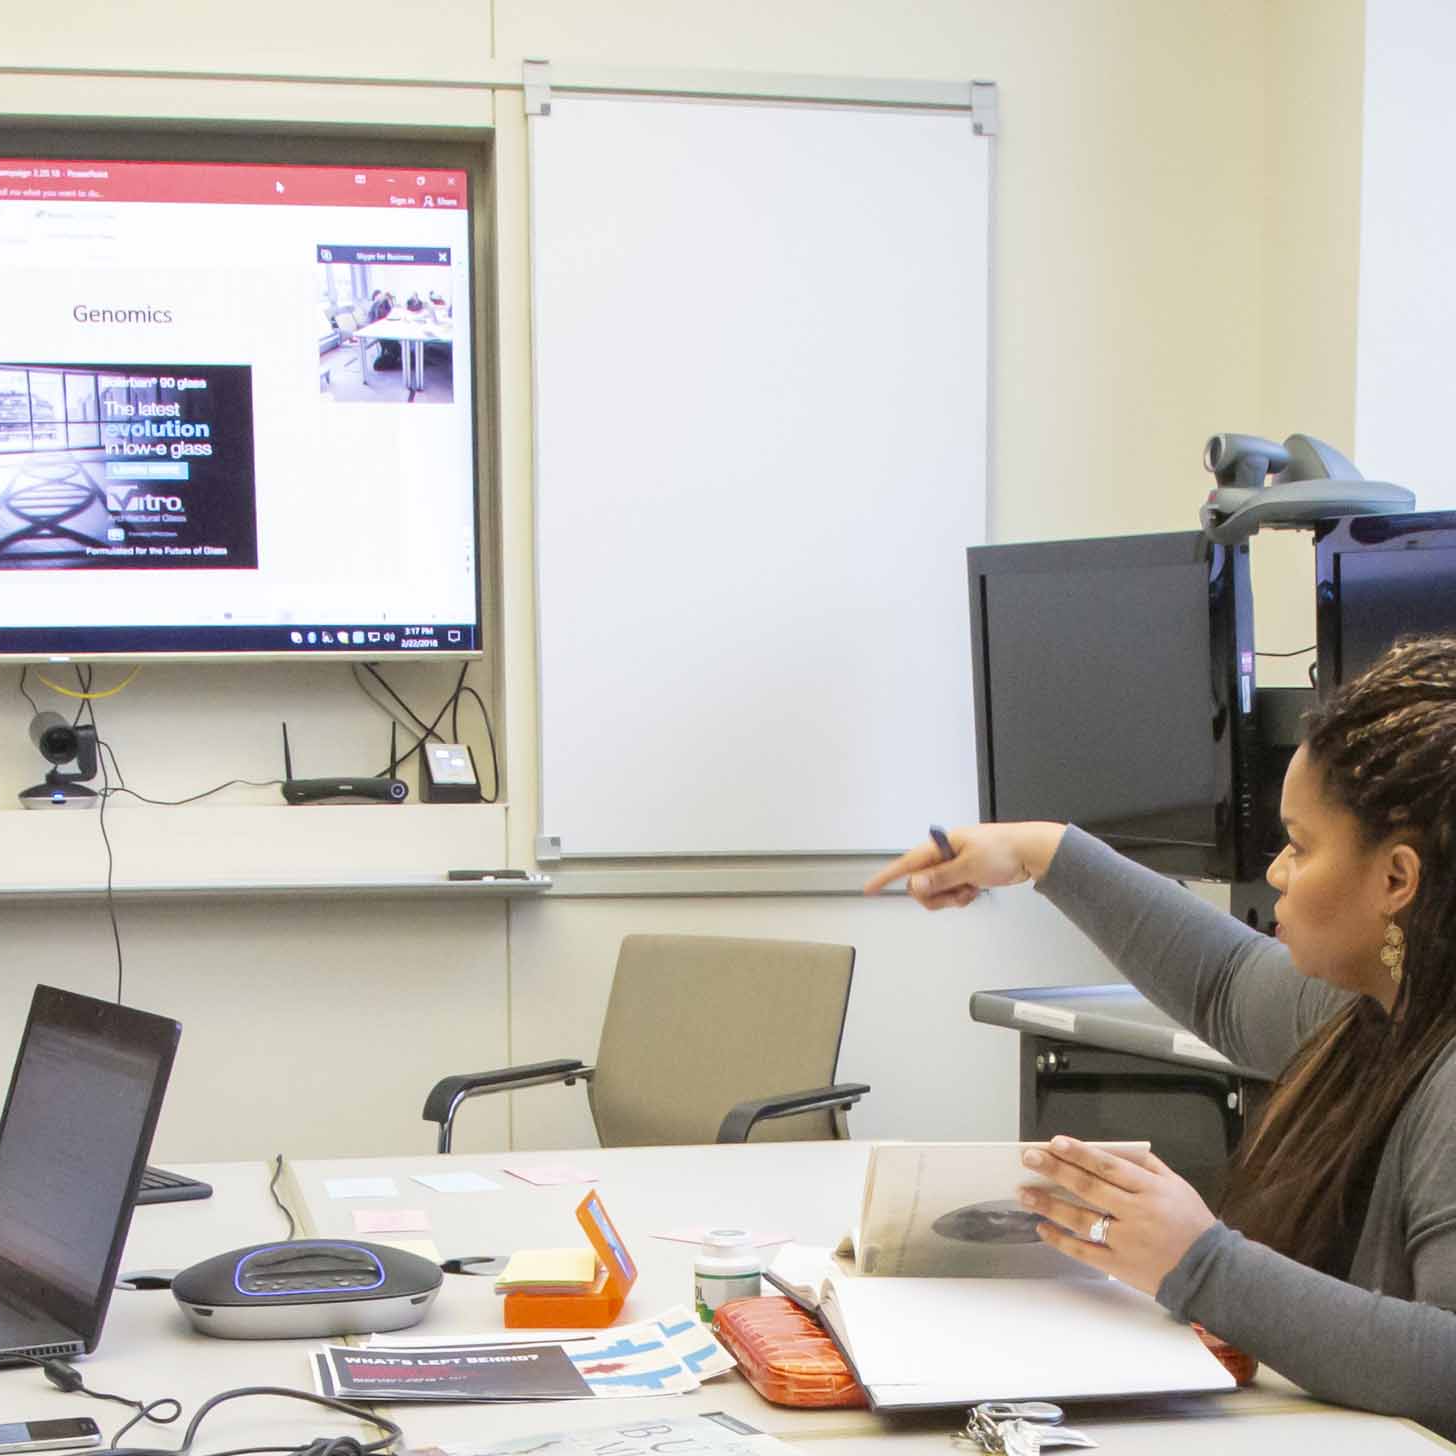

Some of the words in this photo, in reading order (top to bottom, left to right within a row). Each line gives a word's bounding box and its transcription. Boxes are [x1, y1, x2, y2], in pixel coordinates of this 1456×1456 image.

[390, 196, 406, 206] Sign
[437, 197, 457, 206] Share
[72, 304, 174, 323] Genomics
[159, 377, 175, 389] 90
[177, 378, 207, 391] glass
[104, 401, 134, 417] The
[138, 401, 181, 417] latest
[105, 420, 211, 438] evolution
[105, 442, 120, 457] in
[121, 442, 168, 457] low-e
[171, 442, 213, 459] glass
[86, 546, 134, 556] Formulated
[135, 547, 147, 556] for
[148, 547, 163, 556] the
[164, 546, 192, 556] Future
[192, 546, 202, 556] of
[203, 546, 228, 556] Glass
[404, 627, 419, 636] 3:17
[421, 627, 434, 636] PM
[344, 1356, 413, 1366] WHAT'S
[417, 1357, 462, 1366] LEFT
[465, 1354, 539, 1365] BEHIND?
